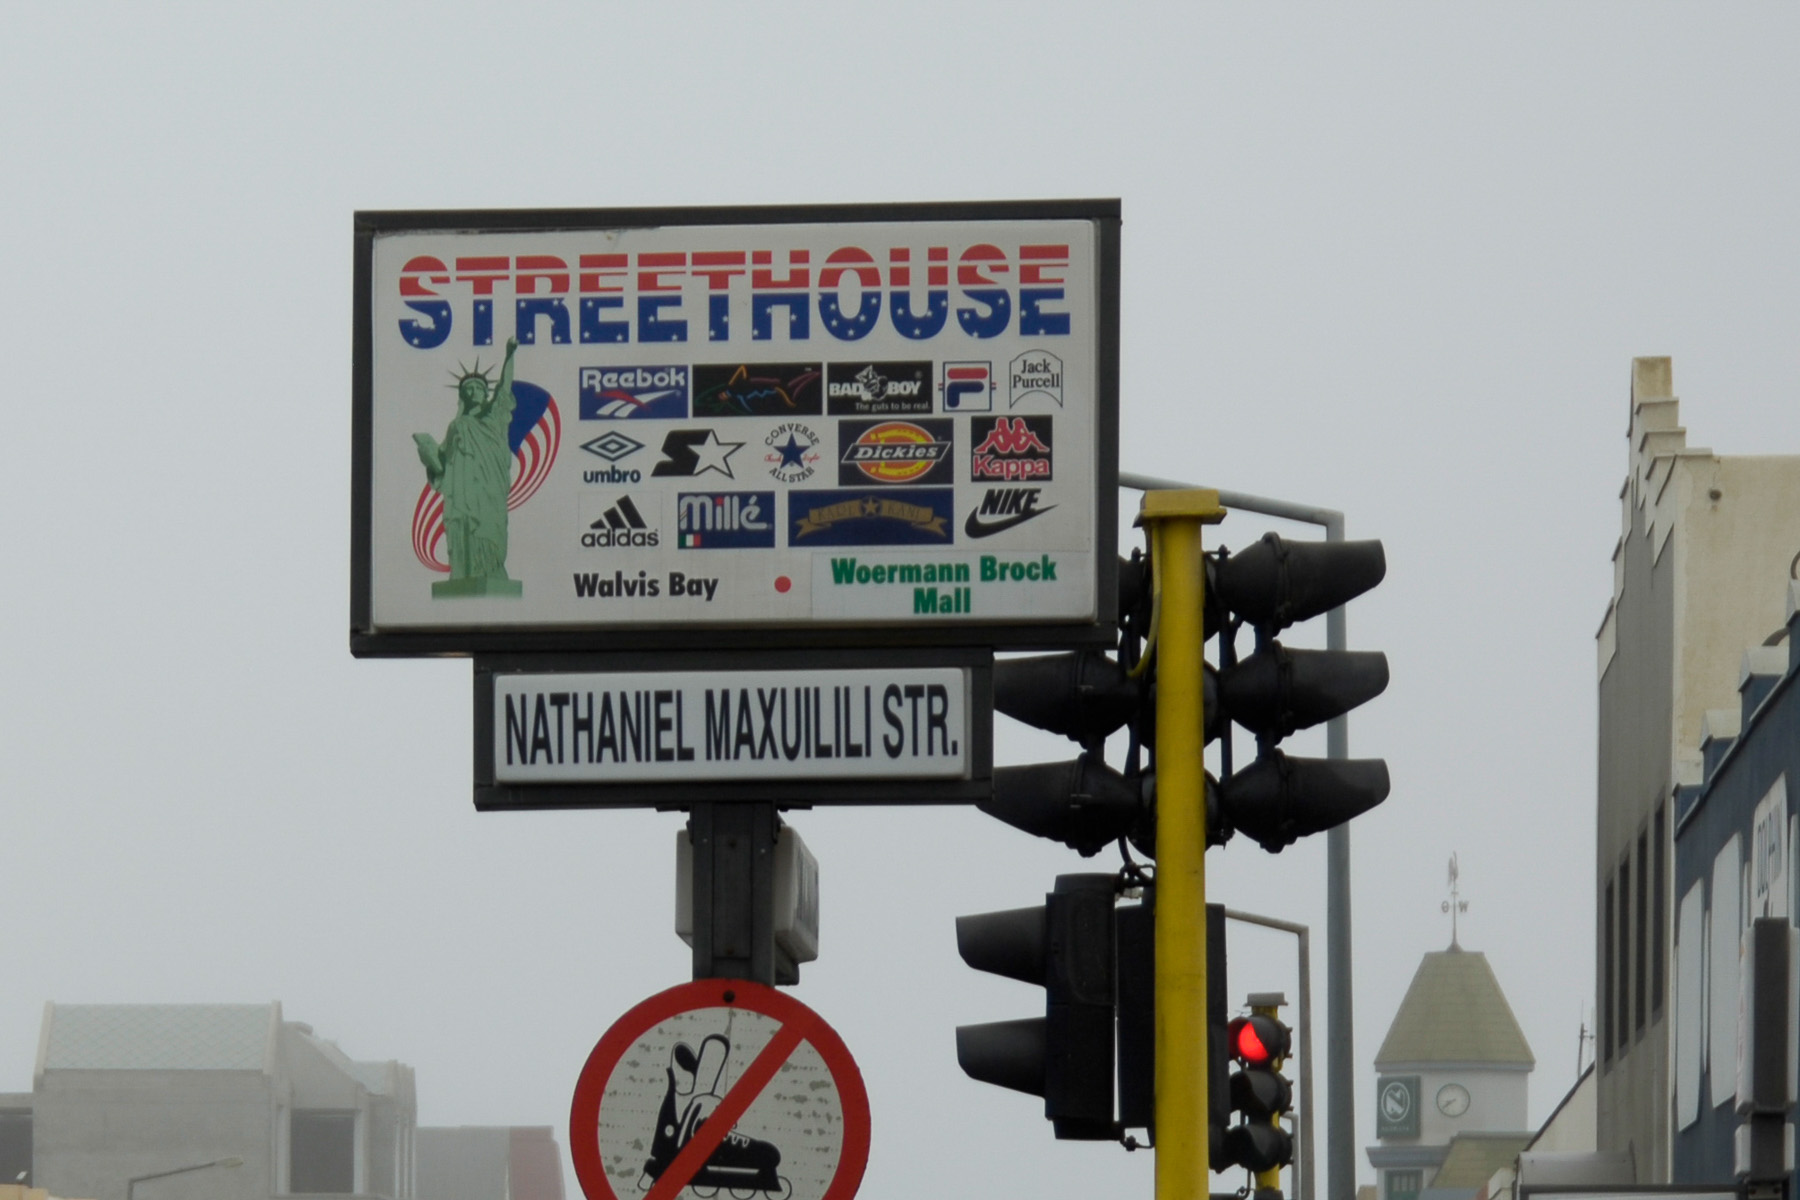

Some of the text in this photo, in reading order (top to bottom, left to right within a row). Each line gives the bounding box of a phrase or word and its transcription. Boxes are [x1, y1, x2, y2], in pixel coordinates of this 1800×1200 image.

[398, 244, 1070, 350] STREETHOUSE
[1020, 358, 1051, 374] Jack
[582, 367, 685, 392] Reebok
[829, 380, 922, 397] BAD BOY
[1012, 373, 1060, 390] Purcell
[855, 402, 870, 411] The
[871, 402, 890, 413] guts
[891, 402, 900, 411] to
[901, 401, 911, 410] be
[764, 422, 821, 446] CONVERSE
[853, 444, 939, 460] Dickies
[583, 465, 641, 484] umbro
[768, 465, 815, 483] ALL STAR
[972, 454, 1050, 481] Kappa
[978, 488, 1042, 515] NIKE
[580, 528, 660, 547] adidas
[831, 554, 1058, 585] Woermann Brock
[573, 570, 719, 602] Walvis Bay
[913, 587, 971, 614] Mall
[504, 683, 959, 766] NATHANIEL MAXUILILI STR.
